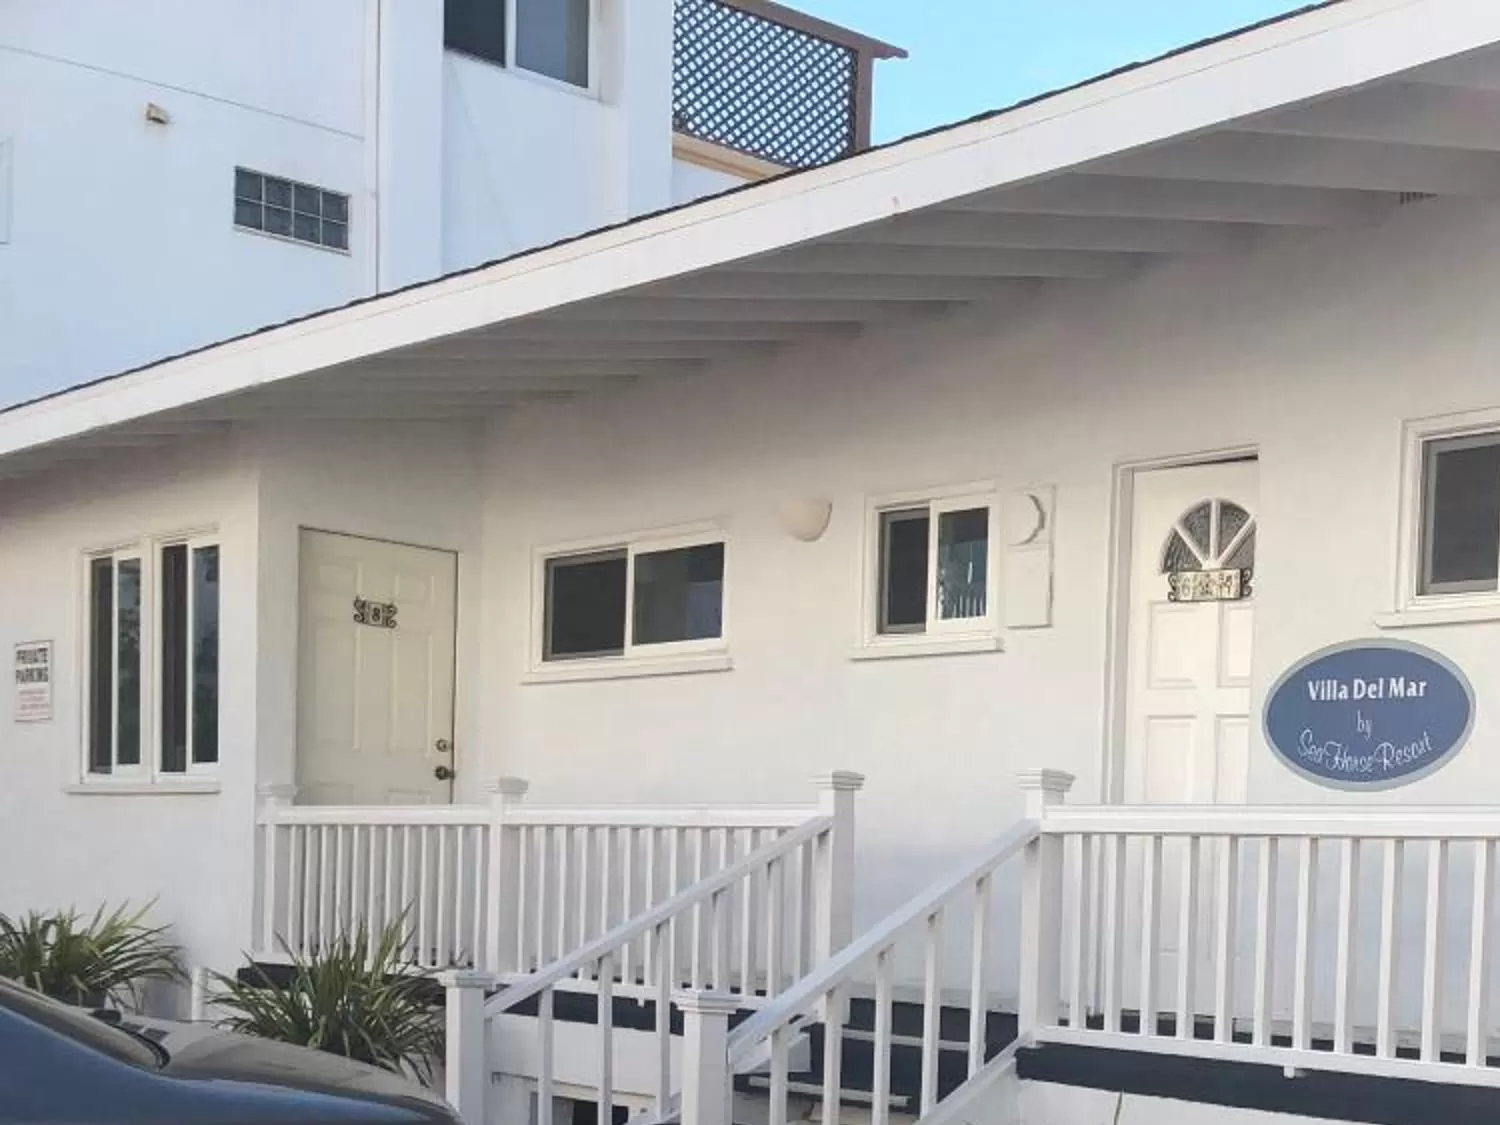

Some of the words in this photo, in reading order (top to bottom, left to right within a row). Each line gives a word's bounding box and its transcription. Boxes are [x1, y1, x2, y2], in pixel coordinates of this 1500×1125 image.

[1307, 679, 1348, 701] Villa
[1353, 677, 1383, 699] Del
[1388, 676, 1427, 698] Mar
[1356, 709, 1373, 739] by
[1374, 731, 1432, 771] Resort
